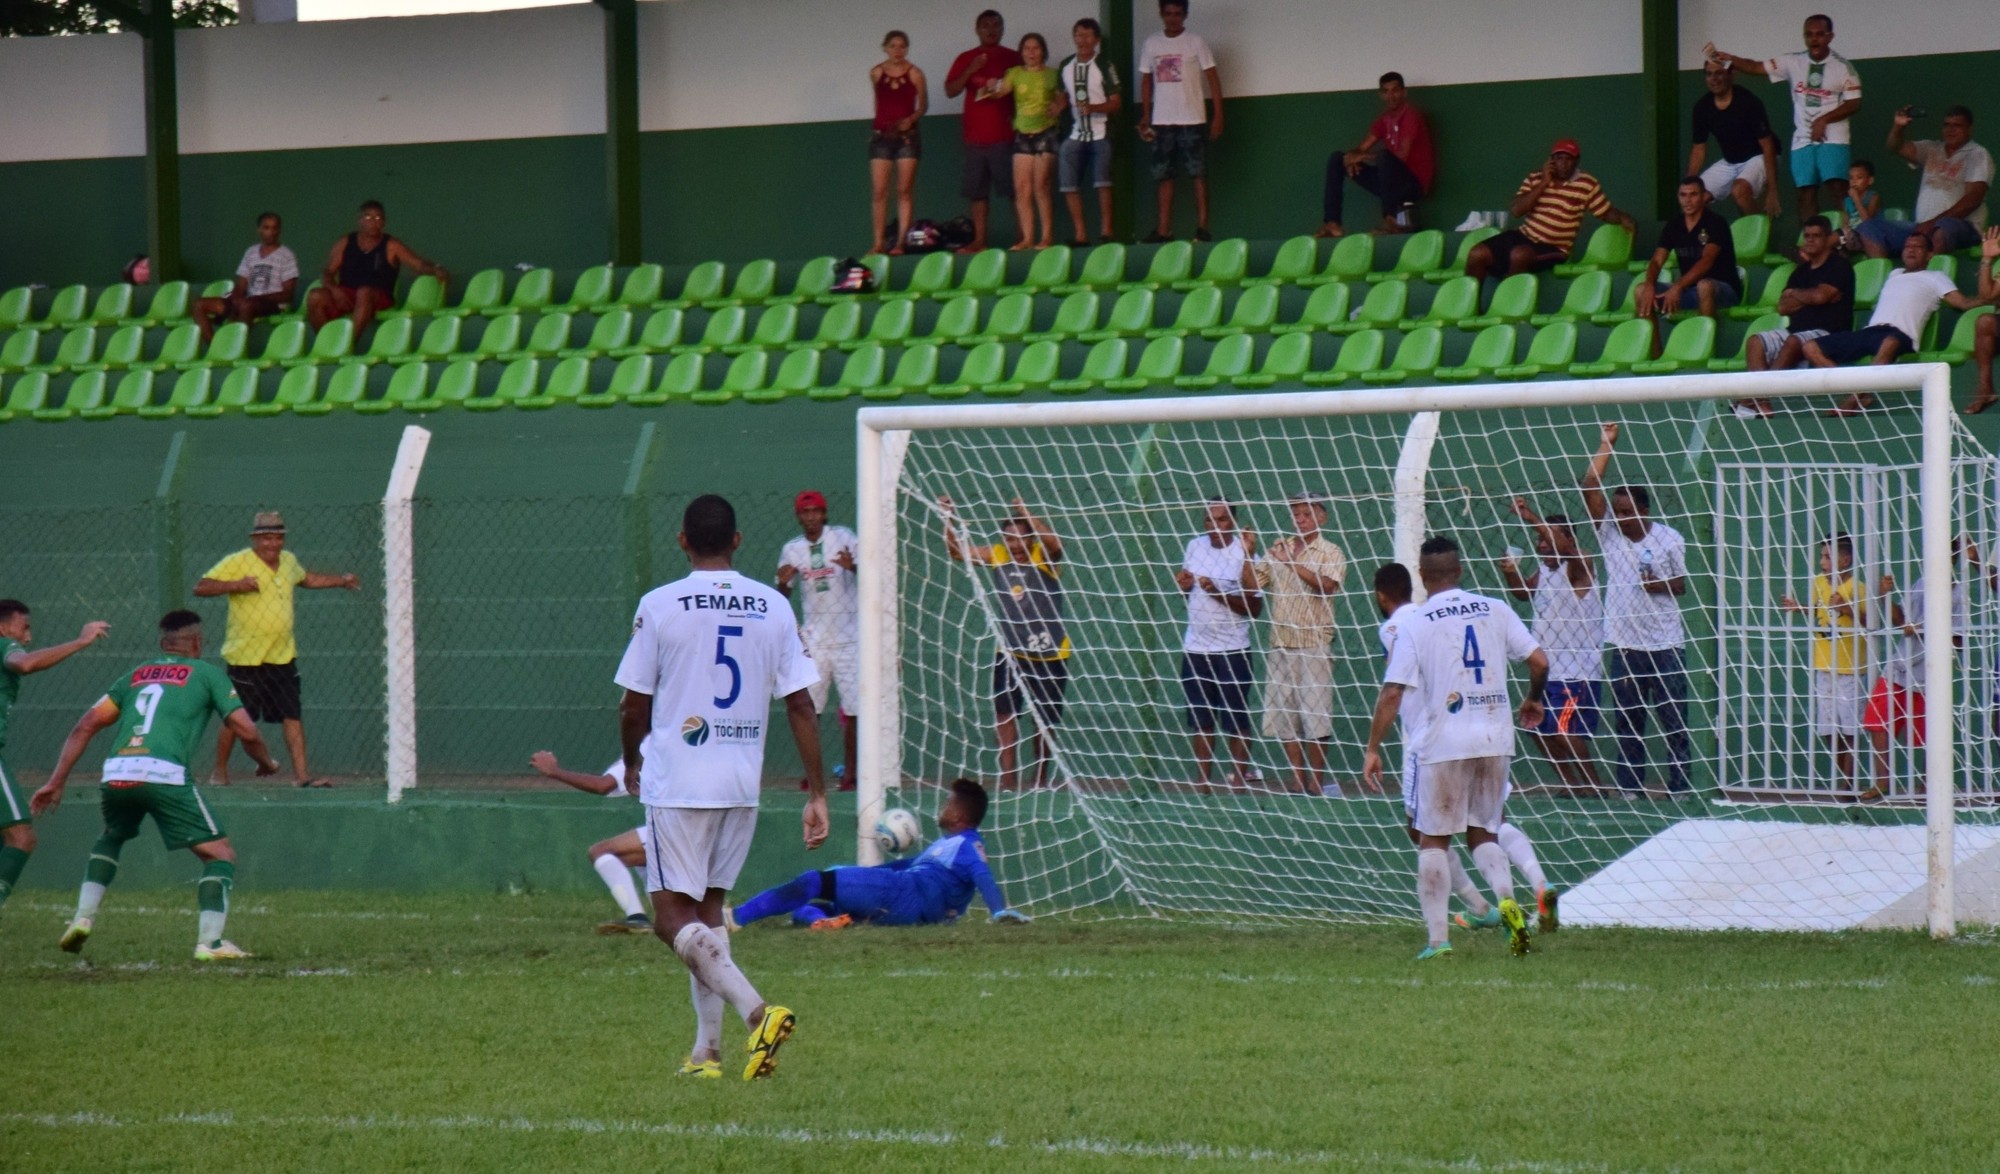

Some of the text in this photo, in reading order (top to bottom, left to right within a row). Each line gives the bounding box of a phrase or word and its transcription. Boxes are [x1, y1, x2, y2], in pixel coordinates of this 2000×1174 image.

[678, 594, 768, 613] TEMAR3
[1425, 601, 1490, 621] TEMAR3
[1027, 631, 1052, 652] 23
[1462, 624, 1485, 684] 4
[713, 625, 743, 709] 5
[134, 683, 165, 735] 9
